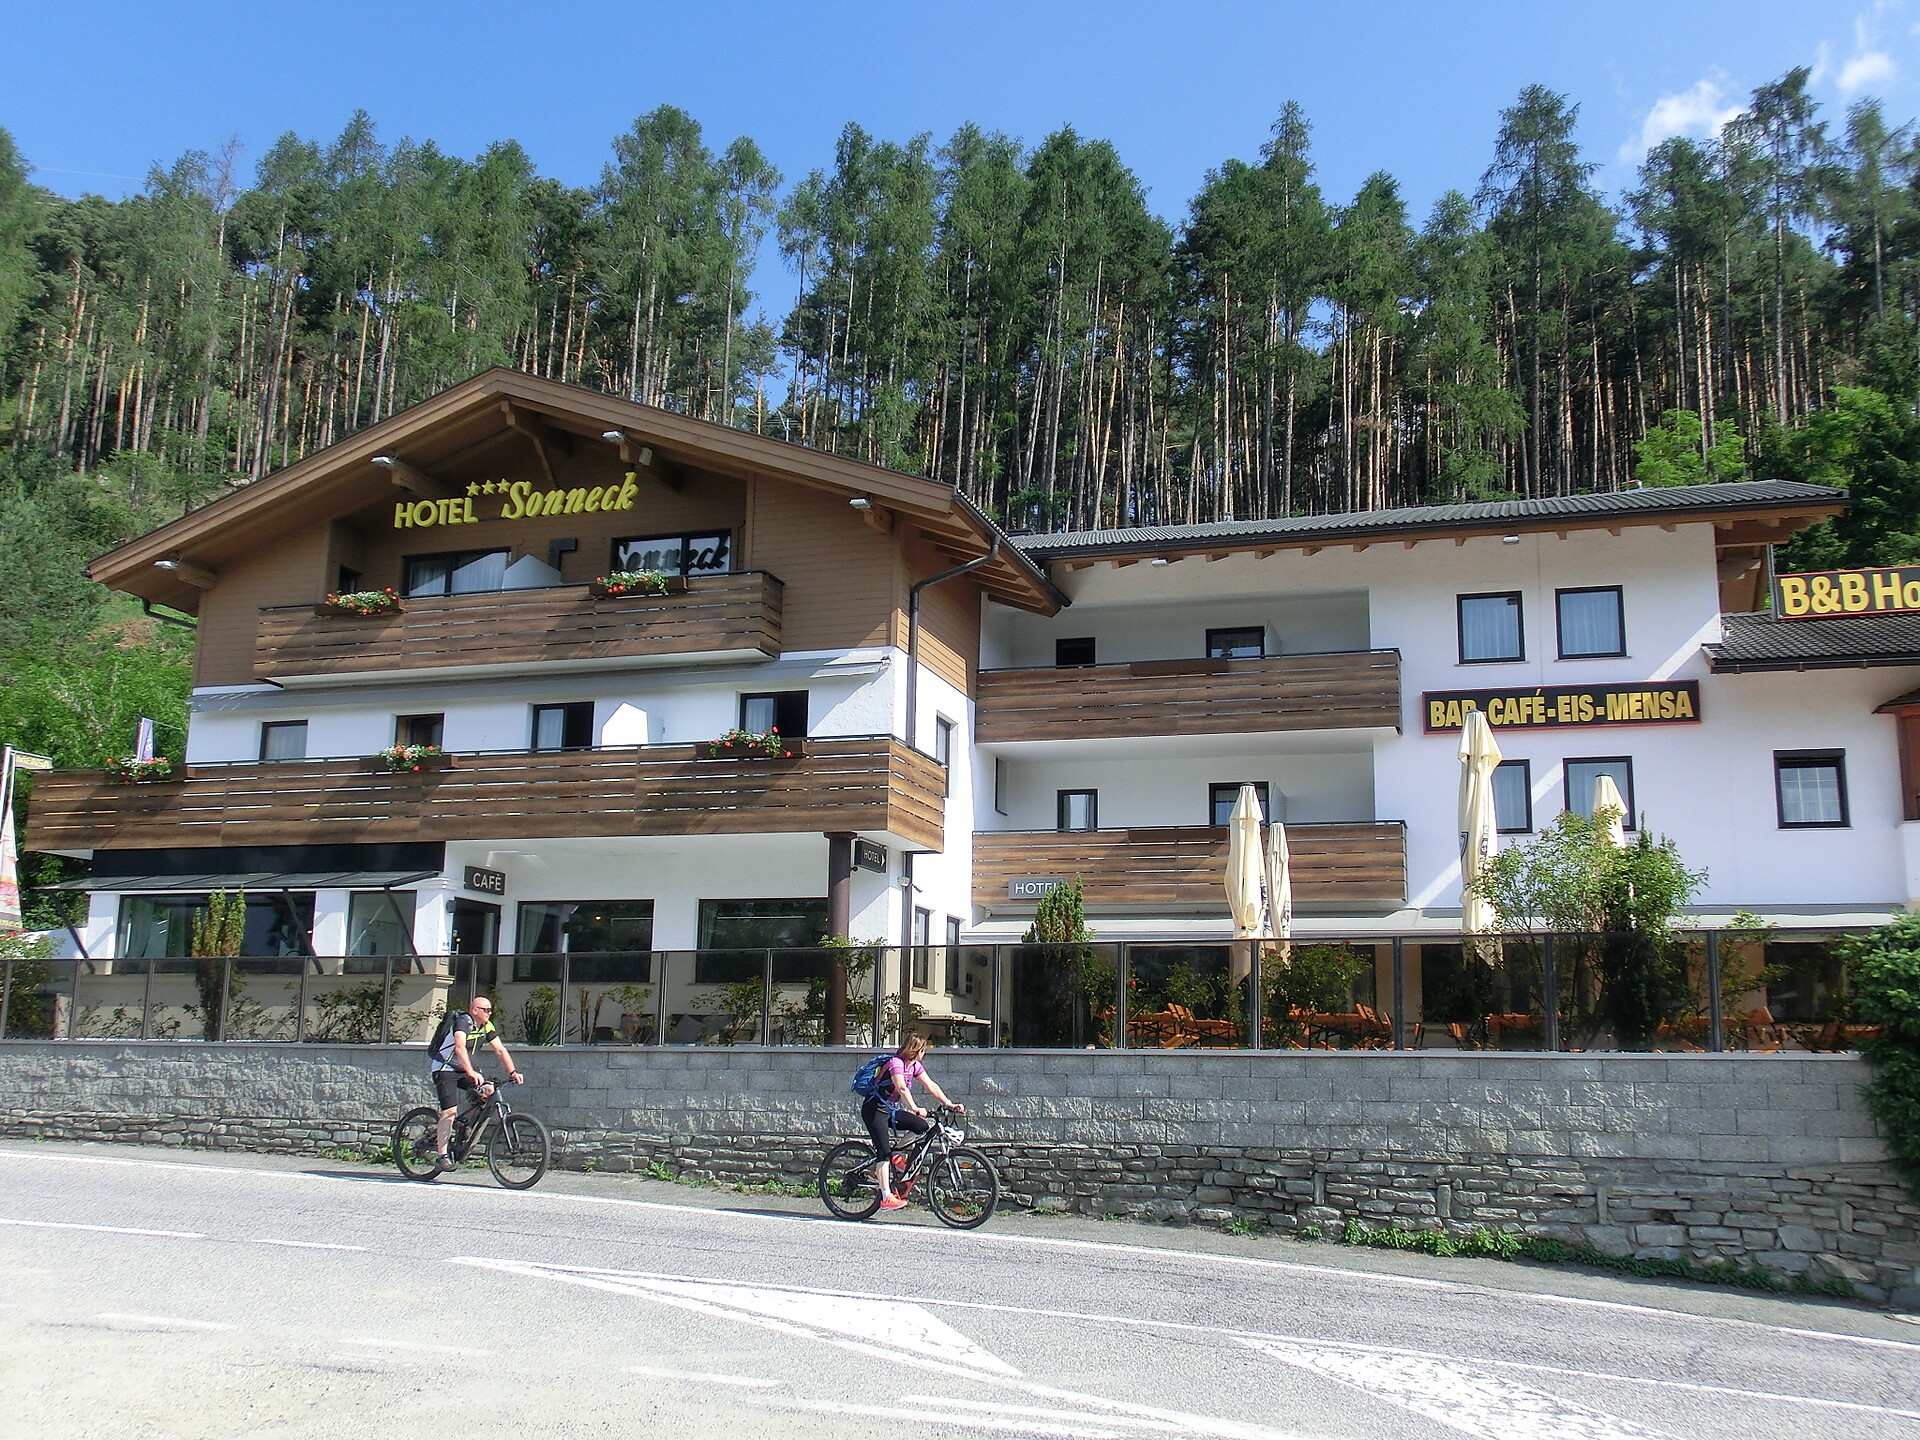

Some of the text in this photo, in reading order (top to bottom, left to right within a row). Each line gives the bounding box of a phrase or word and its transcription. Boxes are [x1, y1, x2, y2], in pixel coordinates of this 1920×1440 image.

[394, 471, 639, 529] HOTEL Sonneck
[1781, 573, 1870, 615] B&B
[863, 849, 880, 864] HOTEL
